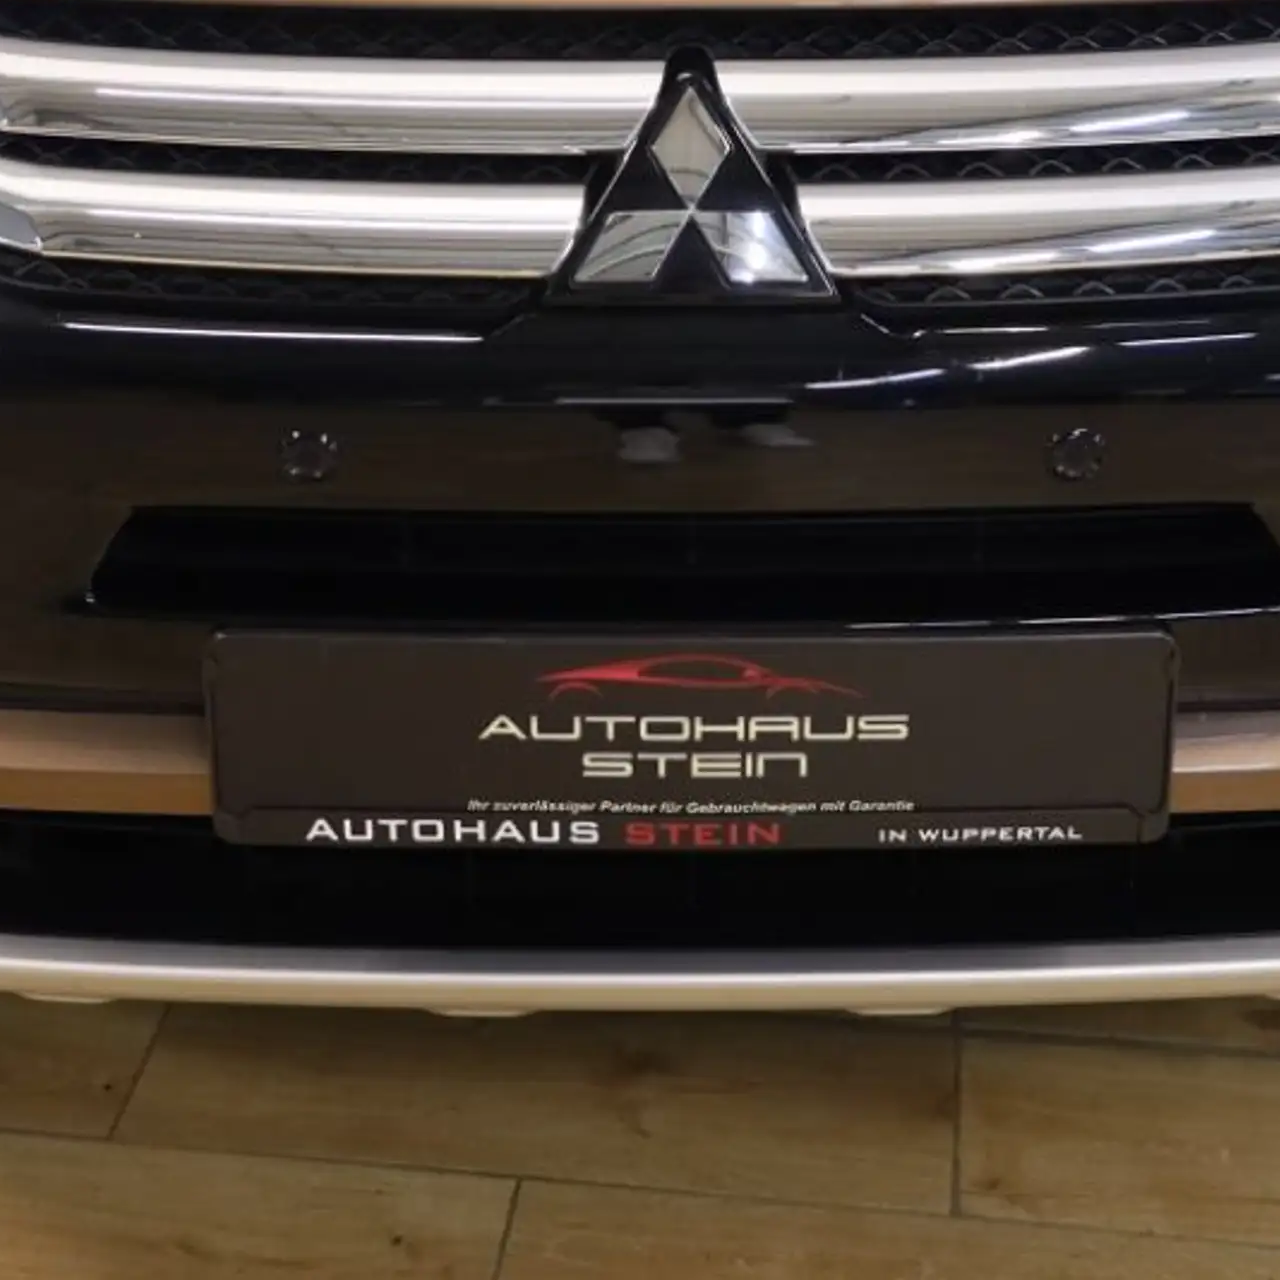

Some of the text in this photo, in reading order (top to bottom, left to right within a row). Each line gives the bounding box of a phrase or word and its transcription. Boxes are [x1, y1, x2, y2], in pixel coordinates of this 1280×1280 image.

[478, 714, 910, 742] AUTOHAUS
[581, 751, 808, 779] STEIN
[466, 799, 916, 816] Ihr zuverlässiger Partner für Gebrauchtwagen mit Garantie
[305, 818, 1084, 846] AUTOHAUS STEIN IN WUPPERTAL
